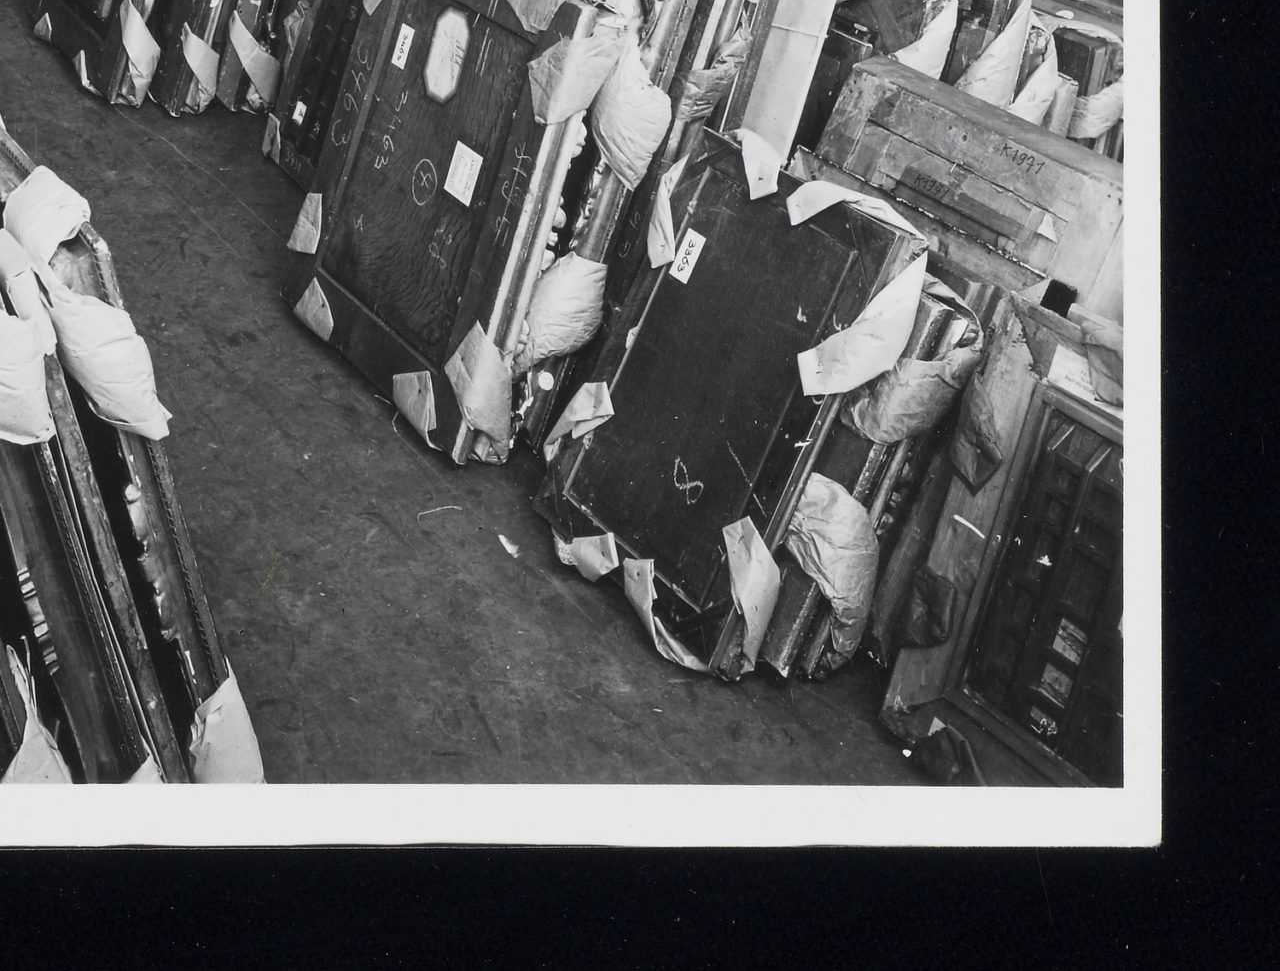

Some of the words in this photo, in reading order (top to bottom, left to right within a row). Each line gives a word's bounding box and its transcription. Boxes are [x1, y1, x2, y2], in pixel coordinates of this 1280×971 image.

[331, 42, 374, 146] 3463
[374, 90, 409, 170] 3463
[1000, 143, 1046, 176] K1971
[676, 239, 697, 273] 3363
